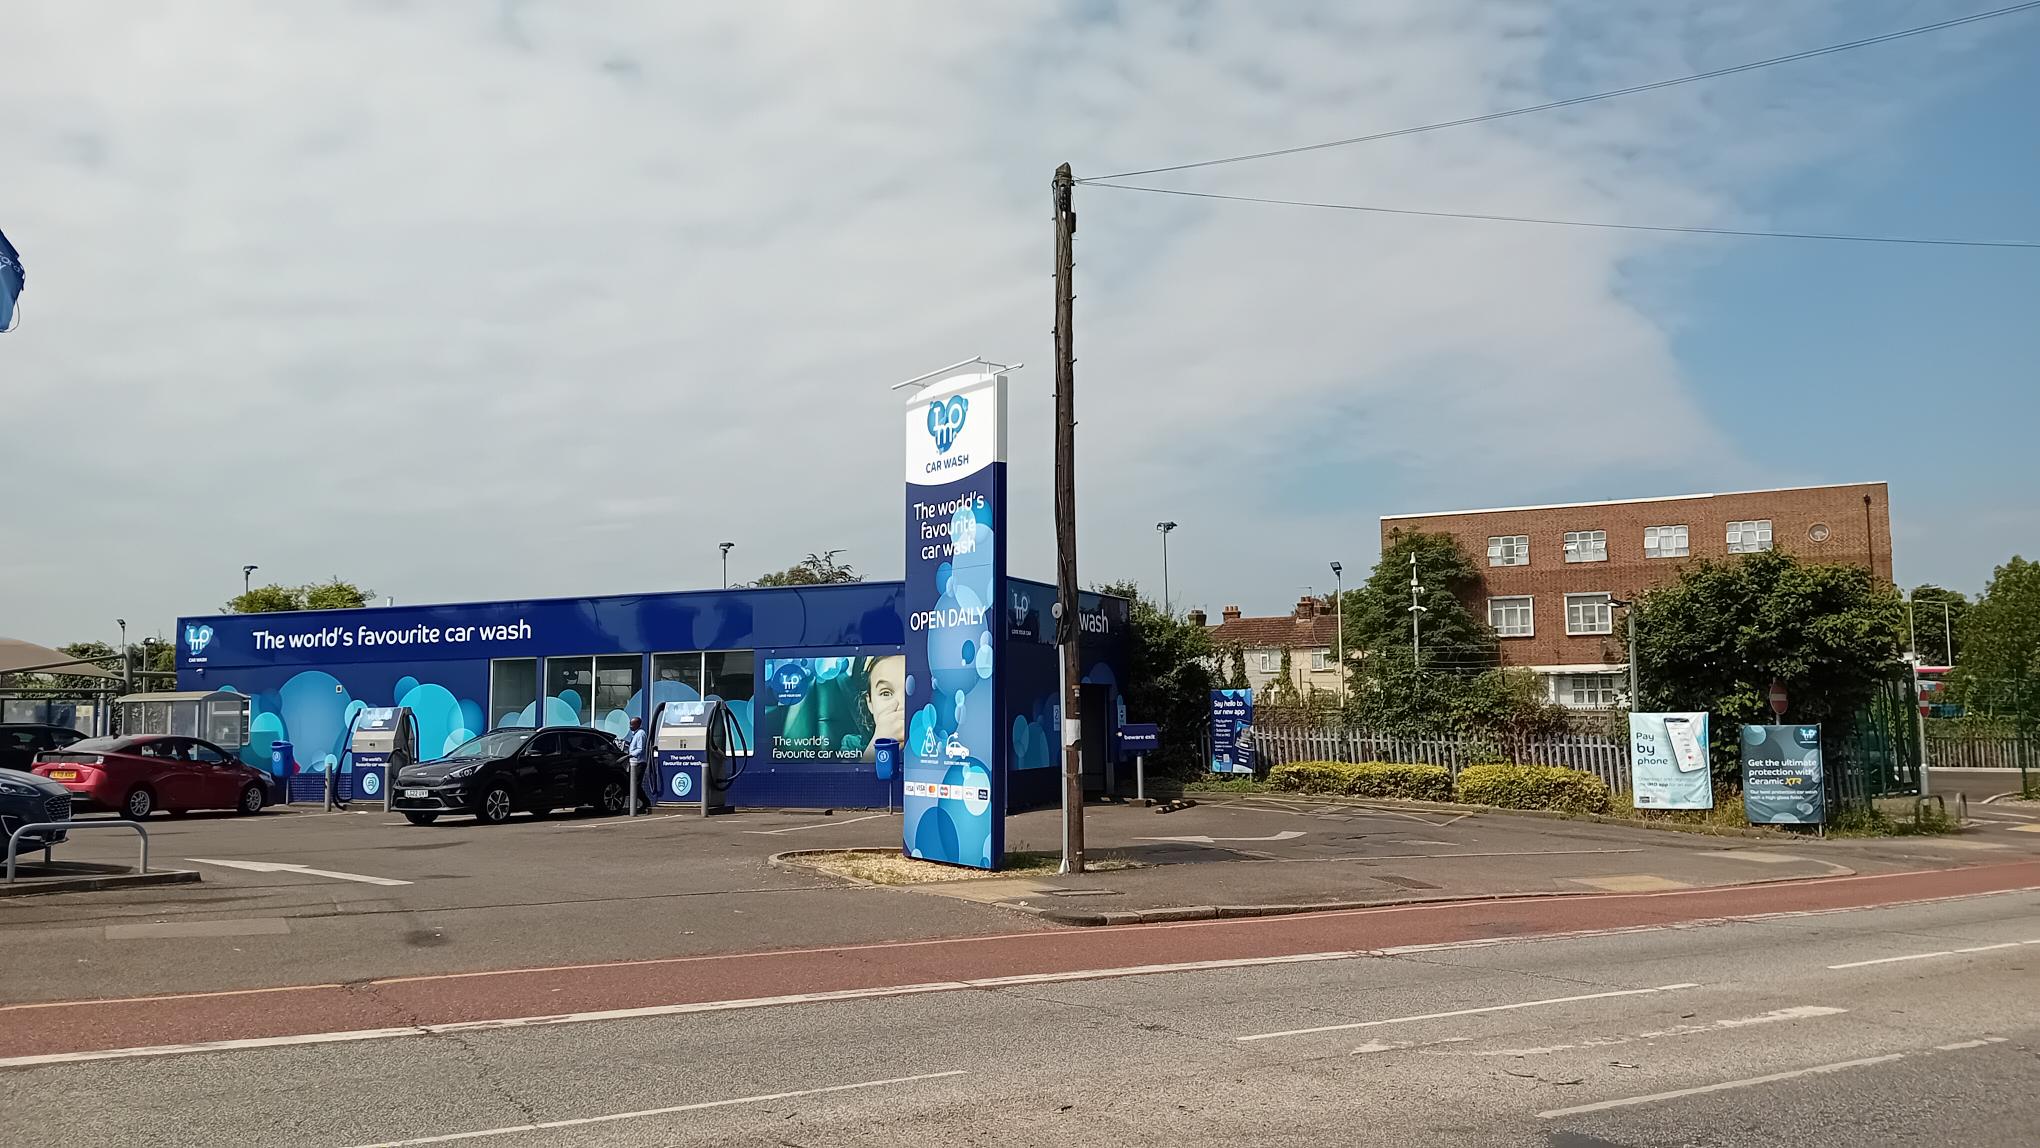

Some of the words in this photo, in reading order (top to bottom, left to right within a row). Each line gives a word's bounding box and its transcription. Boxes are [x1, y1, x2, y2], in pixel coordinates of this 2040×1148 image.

[925, 461, 942, 474] CAR
[943, 454, 970, 471] WASH
[913, 502, 936, 520] The
[937, 491, 985, 515] world's
[920, 516, 977, 541] favourite
[921, 543, 941, 560] car
[942, 538, 976, 558] wash
[910, 610, 945, 631] OPEN
[948, 606, 986, 627] DAILY
[1079, 609, 1109, 634] wash
[252, 630, 285, 650] The
[288, 626, 353, 648] world's
[357, 624, 440, 646] favourite
[444, 626, 475, 642] car
[479, 619, 532, 641] wash
[1214, 700, 1223, 708] Say
[772, 736, 792, 747] The
[794, 735, 830, 746] world's
[1636, 732, 1655, 742] Pay
[772, 747, 817, 759] favourite
[817, 749, 833, 759] car
[835, 748, 863, 758] wash
[1637, 742, 1655, 756] by
[1637, 757, 1668, 766] phone
[1748, 759, 1764, 767] Get
[1765, 759, 1780, 767] the
[1781, 759, 1817, 767] ultimate
[1748, 768, 1794, 777] protection
[1795, 768, 1815, 776] with
[1749, 777, 1784, 785] Ceramic
[916, 784, 926, 792] VISA
